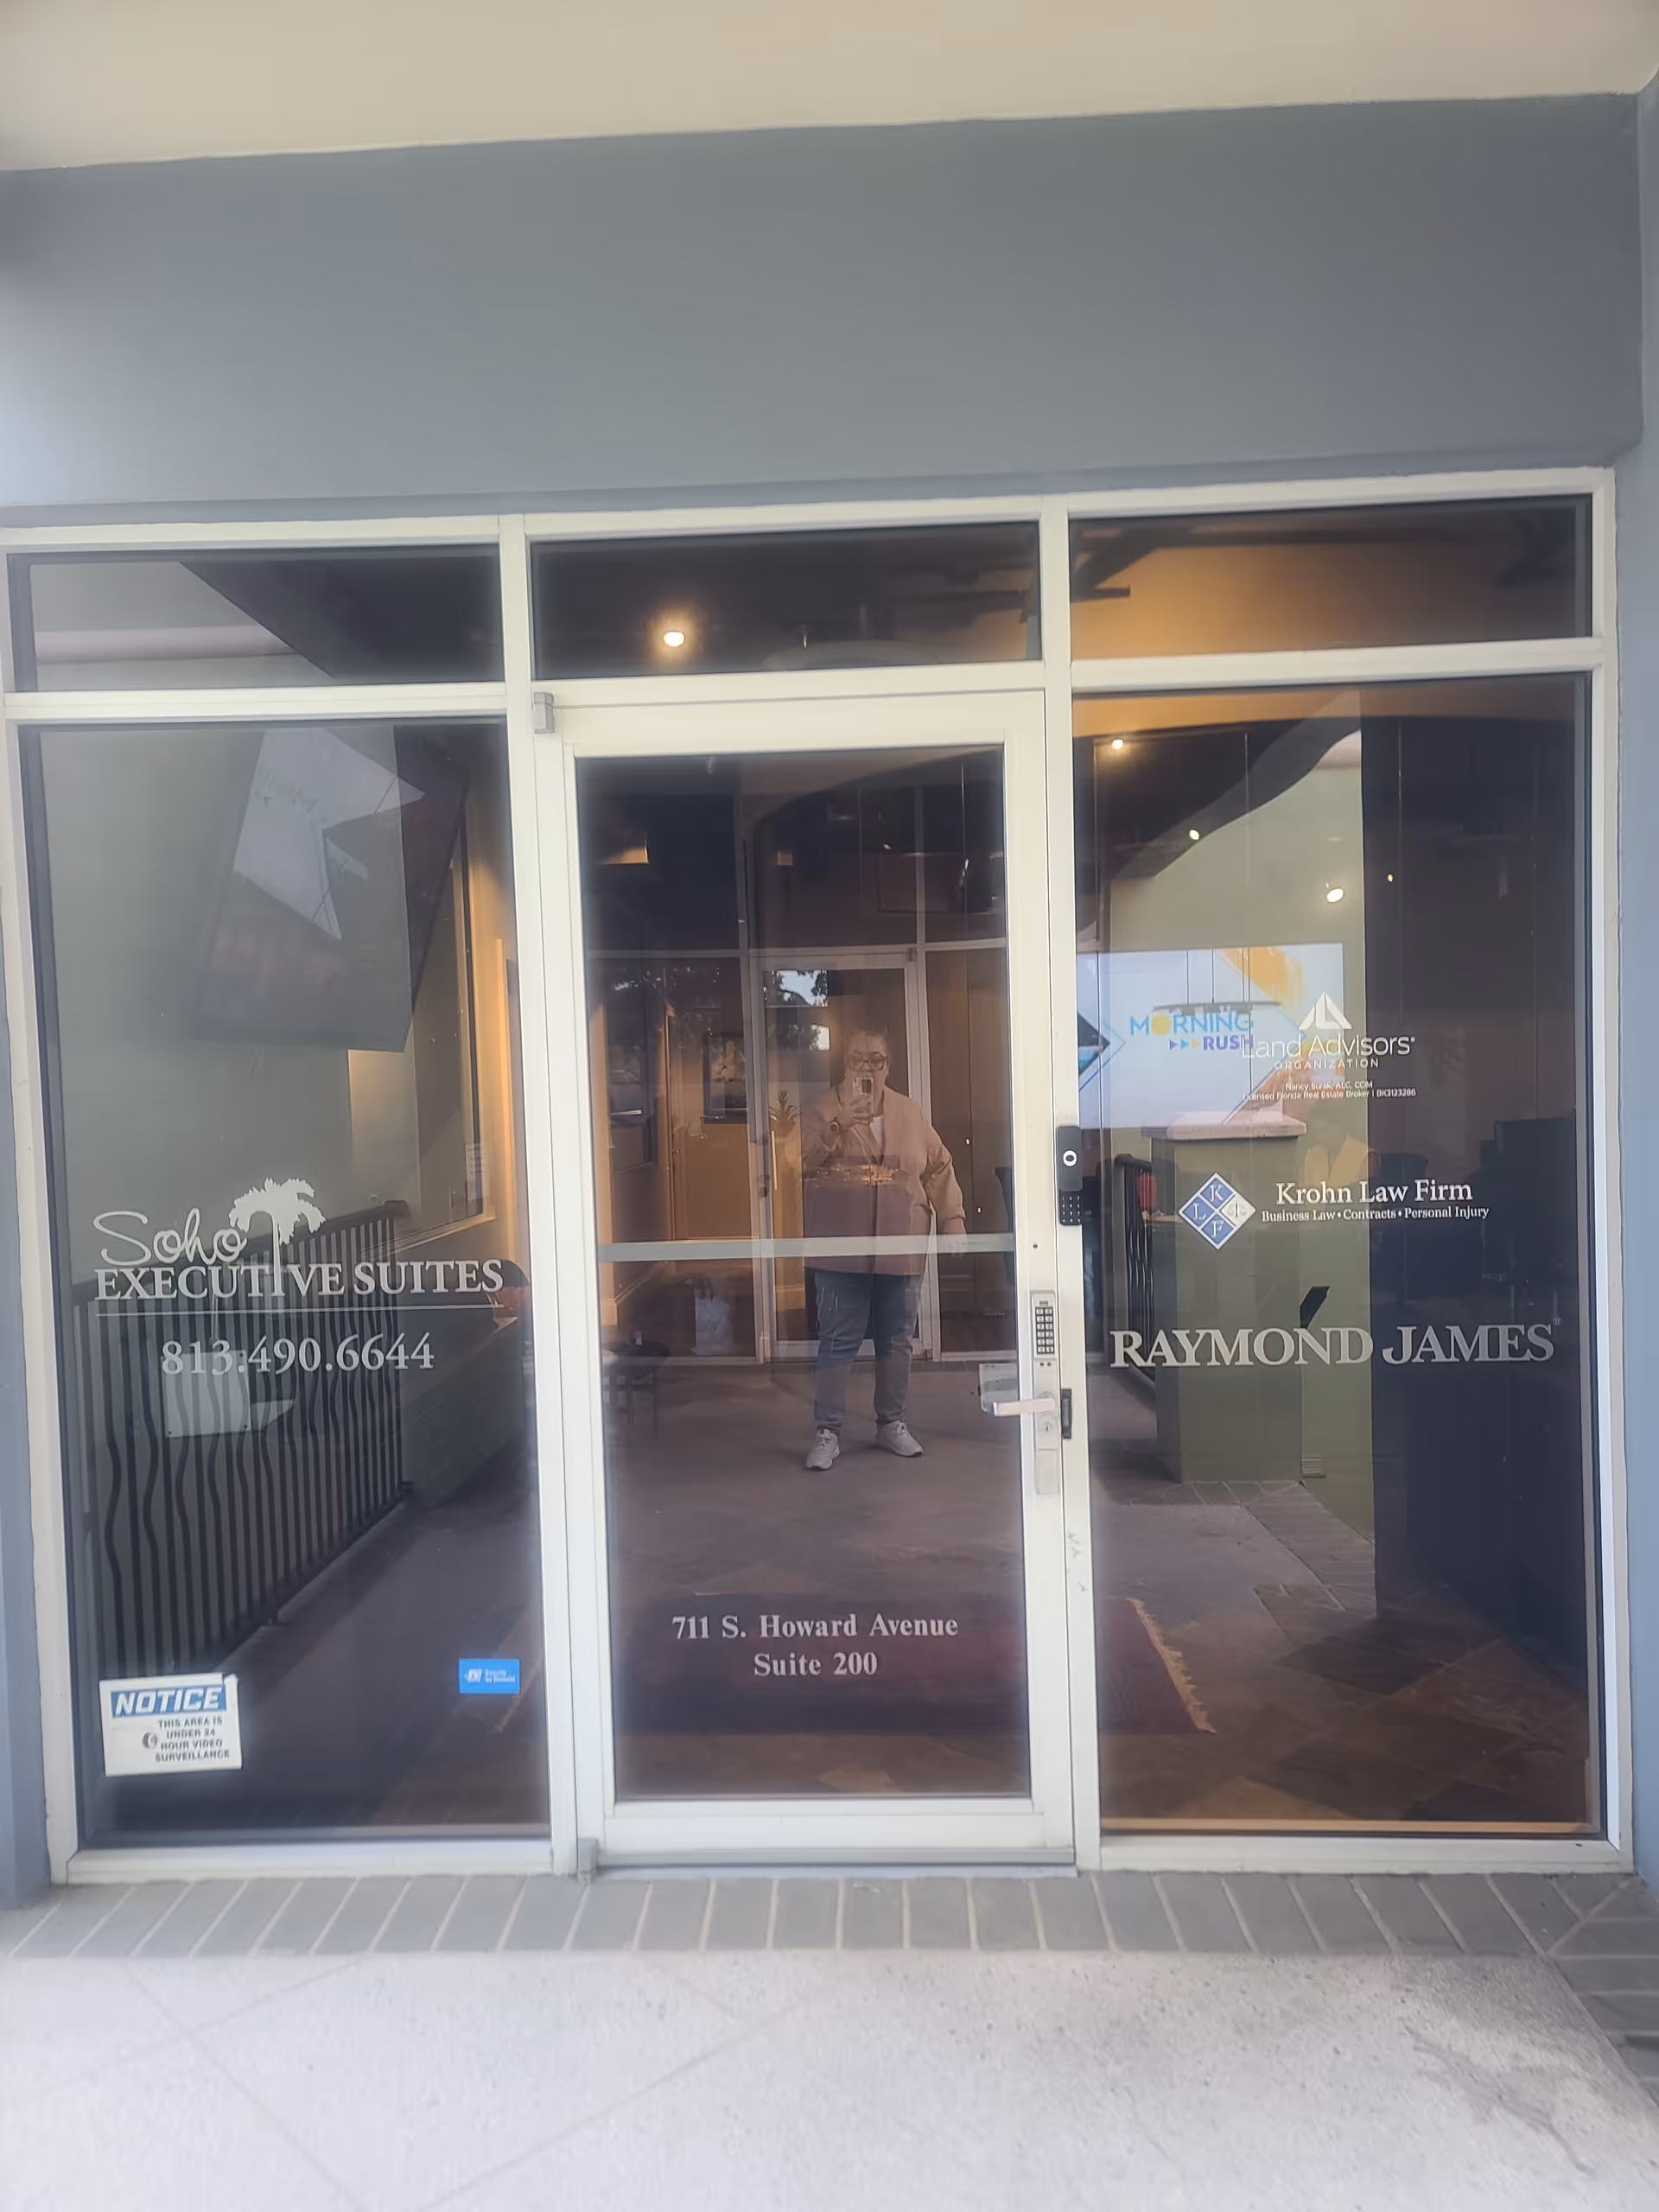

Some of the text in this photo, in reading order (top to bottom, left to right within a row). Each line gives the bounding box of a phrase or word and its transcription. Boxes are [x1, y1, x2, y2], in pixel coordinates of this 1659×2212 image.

[1130, 1010, 1254, 1036] MORNING
[1203, 1035, 1253, 1051] RUSH
[1241, 1035, 1302, 1058] Land
[1274, 1058, 1379, 1070] ORGANIZATION
[1243, 1090, 1275, 1101] Licensed
[1276, 1090, 1301, 1100] Florida
[1303, 1090, 1319, 1099] Real
[1321, 1090, 1344, 1099] Estate
[1345, 1089, 1370, 1098] Broker
[1285, 1082, 1309, 1092] Nancy
[1210, 1185, 1225, 1202] K
[1274, 1179, 1473, 1205] Krohn Law Firm
[1262, 1205, 1490, 1222] Business Law Contracts Personal Injury
[93, 1208, 247, 1266] Soho
[93, 1259, 504, 1300] EXECUTIVE SUITES
[161, 1332, 435, 1376] 813.490.6644
[1109, 1323, 1554, 1368] RAYMOND JAMES
[671, 1613, 958, 1639] 711 S. Howard Avenue
[753, 1651, 879, 1676] Suite 200
[114, 1687, 223, 1716] NOTICE
[158, 1715, 223, 1729] THIS AREA IS
[166, 1727, 215, 1738] UNDER 24
[161, 1738, 223, 1751] HOUR VIDEO
[156, 1749, 230, 1763] SURVEILLANCE
